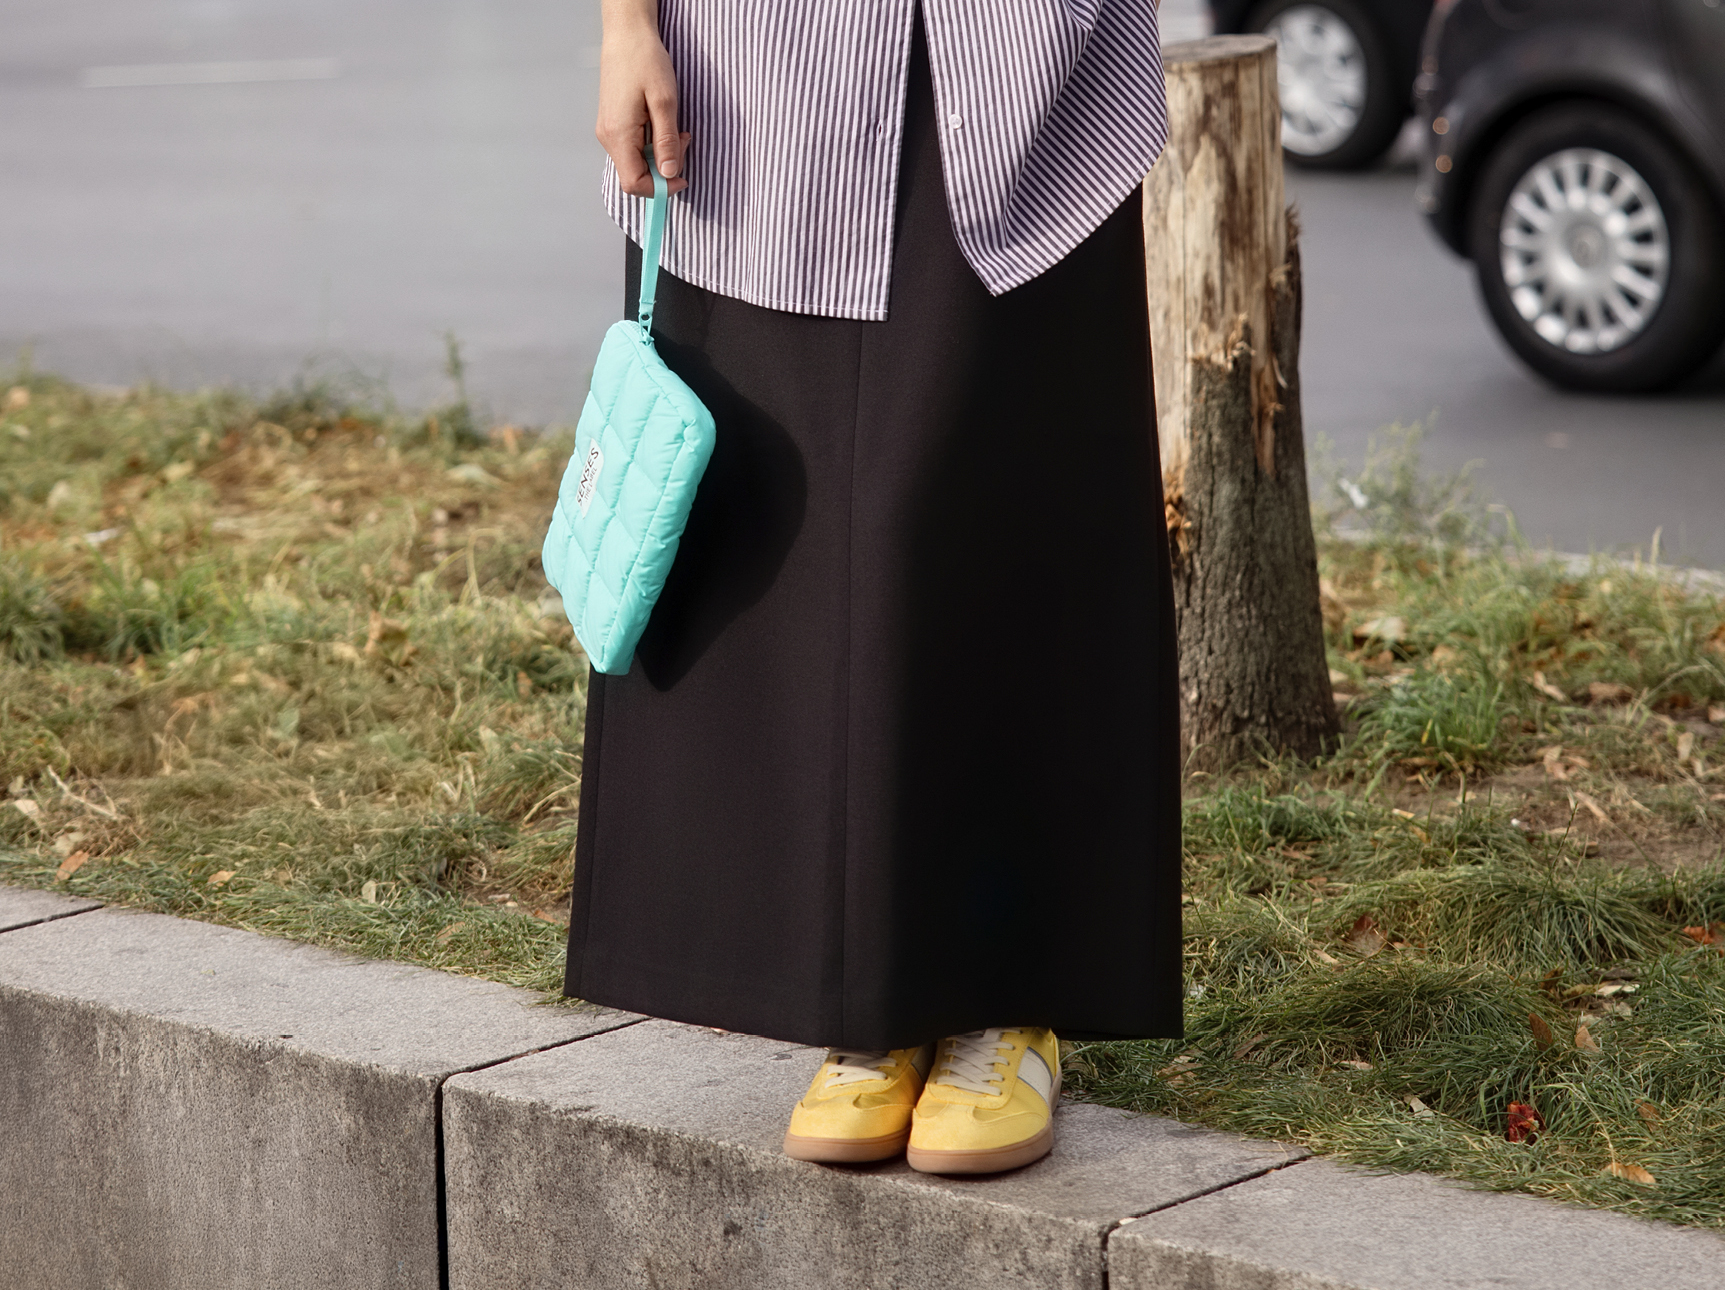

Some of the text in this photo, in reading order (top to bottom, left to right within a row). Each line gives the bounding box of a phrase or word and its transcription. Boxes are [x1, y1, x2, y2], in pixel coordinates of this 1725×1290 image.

[577, 447, 599, 506] SENSES
[584, 467, 598, 501] THE LABEL
